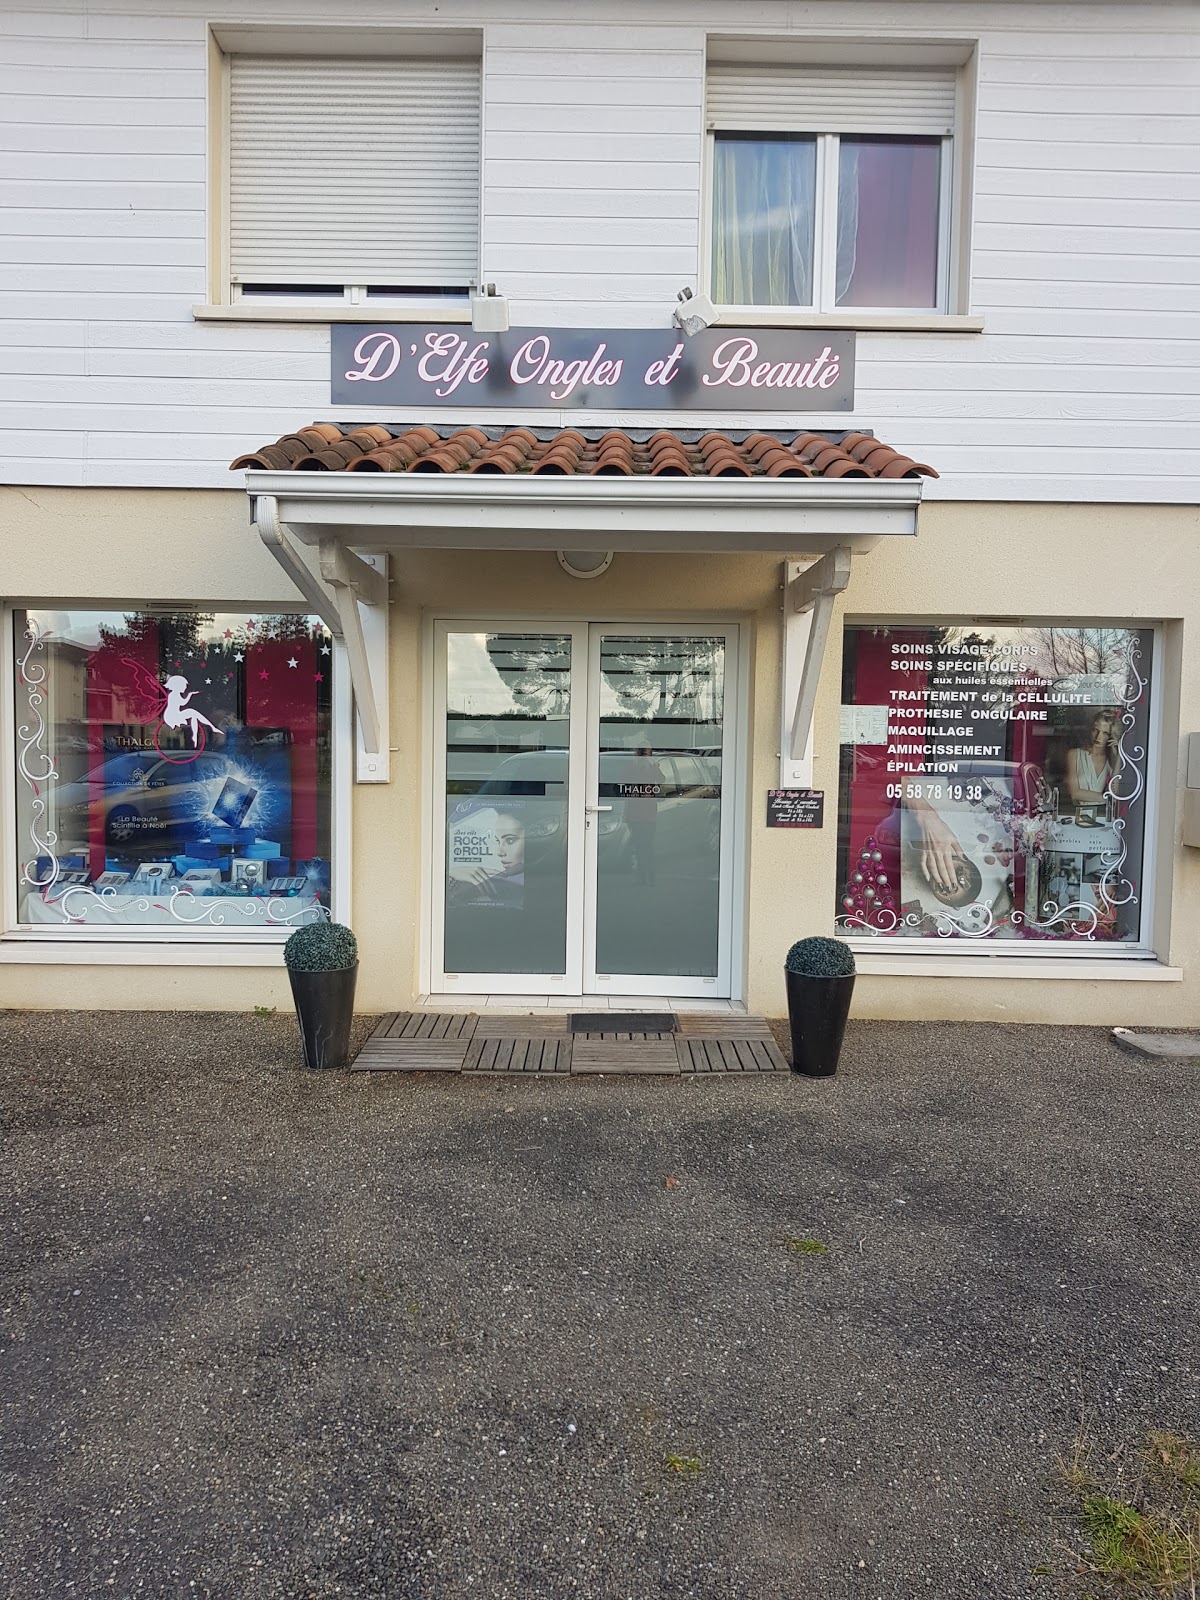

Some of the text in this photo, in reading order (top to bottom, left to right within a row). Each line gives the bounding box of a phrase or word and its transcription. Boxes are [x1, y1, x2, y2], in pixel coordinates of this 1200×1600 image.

[345, 332, 840, 400] D'Elfe Ongles et Beauté
[891, 644, 1038, 656] SOINS VISAGE CORPS
[890, 659, 1028, 672] SOINS SPÉCIFIQUES
[933, 676, 1053, 686] aux huiles essentielles
[889, 690, 978, 702] TRAITEMENT
[981, 692, 998, 702] de
[1002, 693, 1014, 702] la
[1017, 693, 1092, 704] CELLULITE
[888, 708, 1048, 721] PROTHESIE ONGULAIRE
[887, 725, 974, 737] MAQUILLAGE
[115, 736, 160, 747] THALGO
[887, 744, 1002, 756] AMINCISSEMENT
[886, 760, 958, 773] ÉPILATION
[617, 783, 661, 794] THALGO
[886, 784, 982, 800] 05 58 78 19 38
